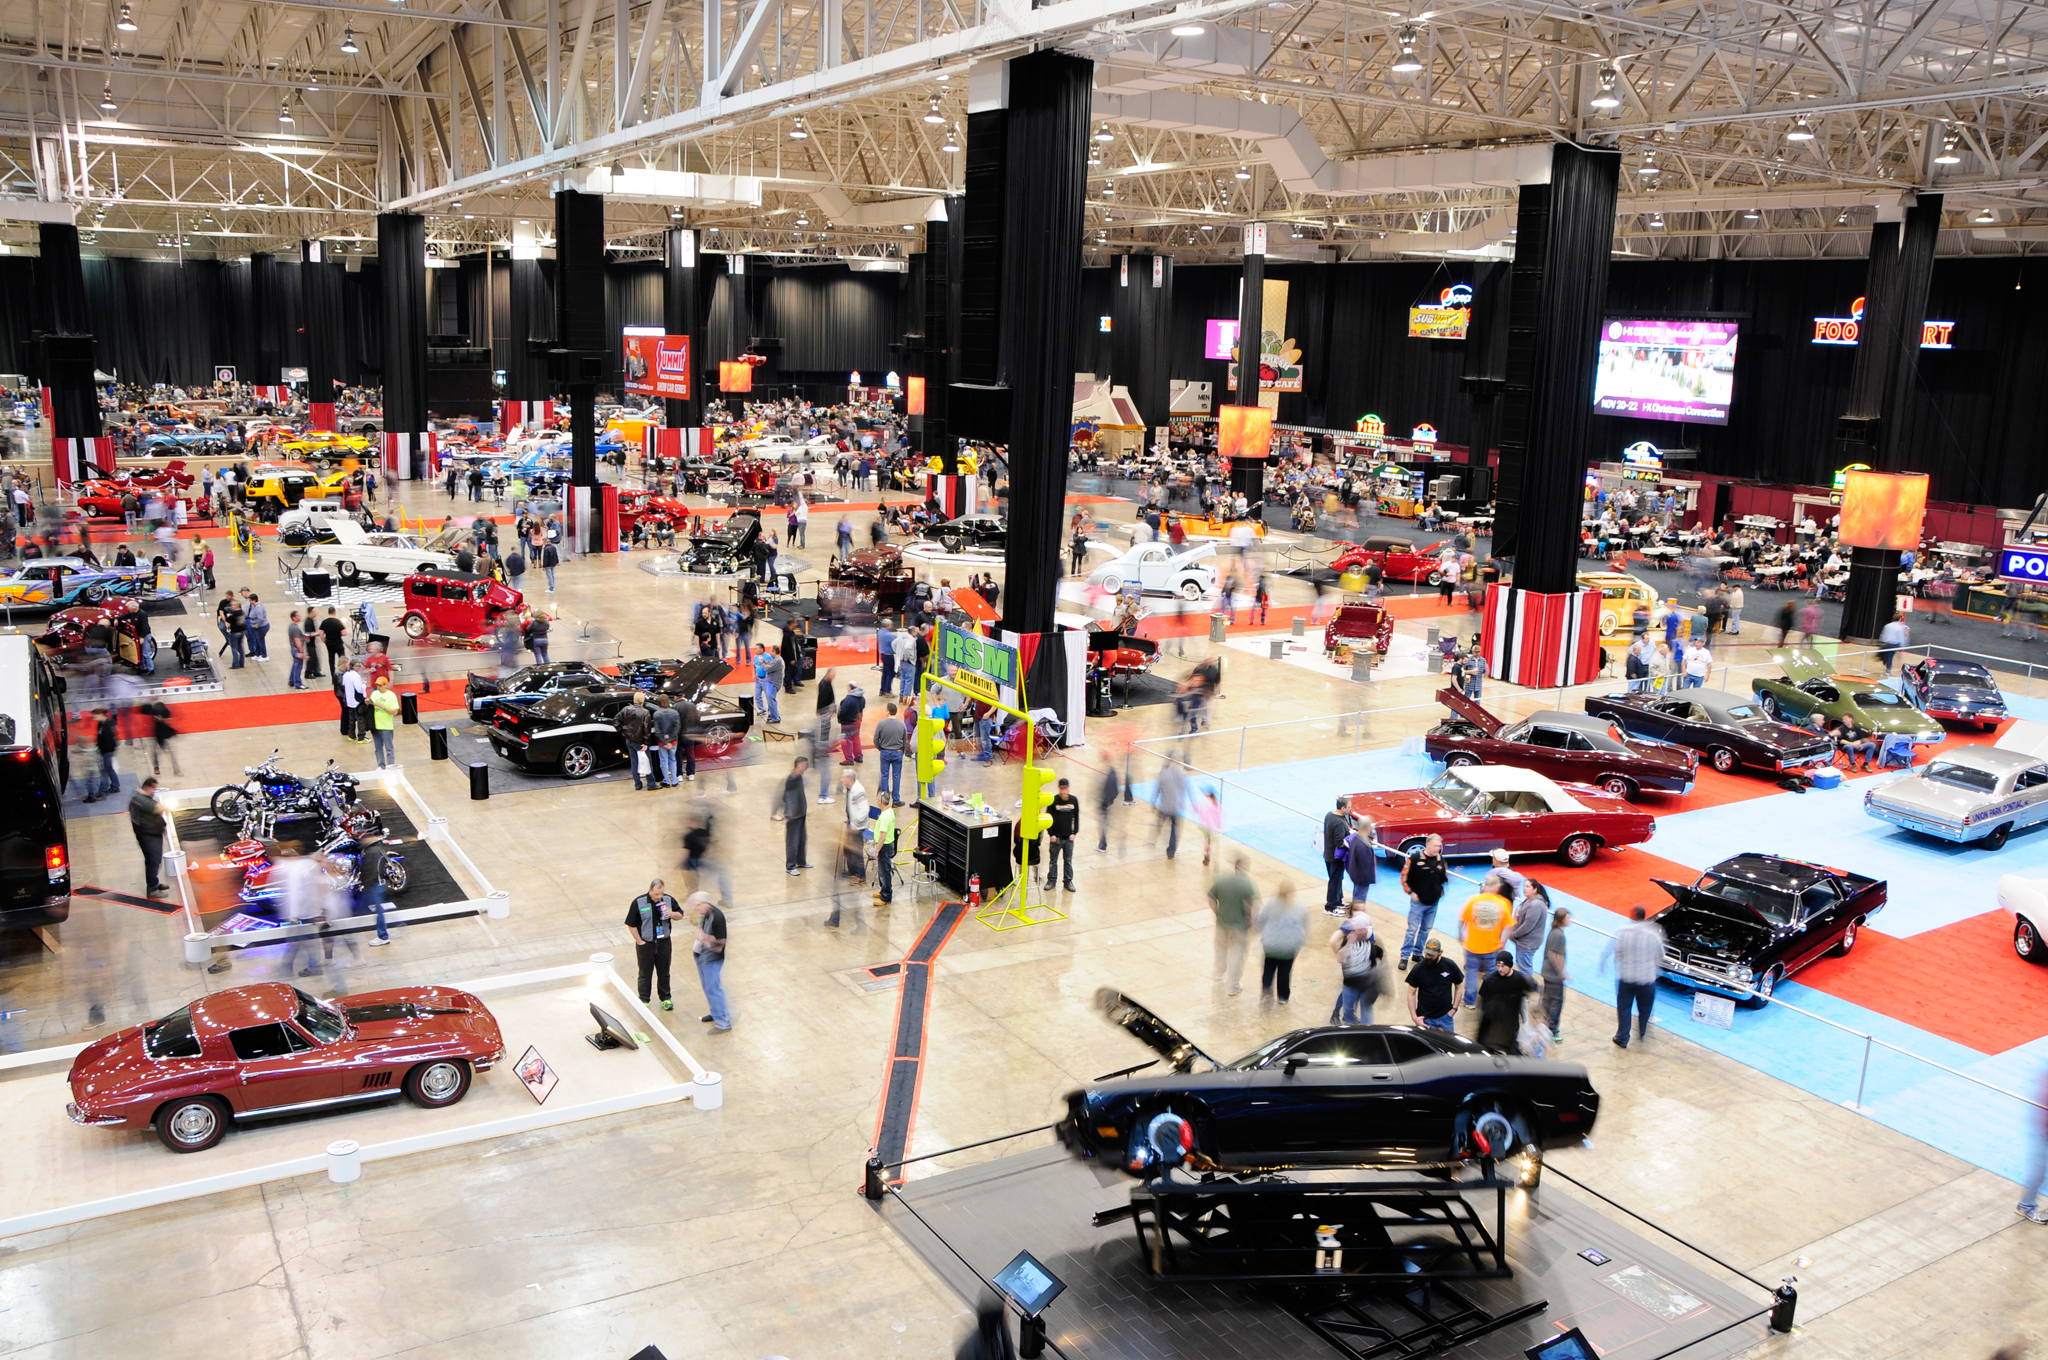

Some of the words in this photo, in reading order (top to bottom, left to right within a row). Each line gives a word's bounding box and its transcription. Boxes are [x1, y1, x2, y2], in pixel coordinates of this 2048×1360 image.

[1413, 312, 1459, 325] SUBWAY
[1815, 321, 1859, 341] FOO
[656, 339, 687, 379] SUMMIT
[1260, 355, 1291, 371] FRESH
[1229, 380, 1272, 388] MET
[1275, 379, 1300, 388] CAFÉ
[1601, 399, 1615, 409] NOV
[1616, 401, 1638, 411] 20-22
[1653, 403, 1686, 415] Christmas
[1686, 407, 1725, 418] Connection
[1357, 421, 1384, 434] PIZZA
[2008, 555, 2048, 577] PO
[945, 629, 1010, 682] RSM
[960, 671, 993, 692] AUTOMOTIVE
[1973, 810, 1989, 822] UNION
[1989, 806, 2003, 816] PARK
